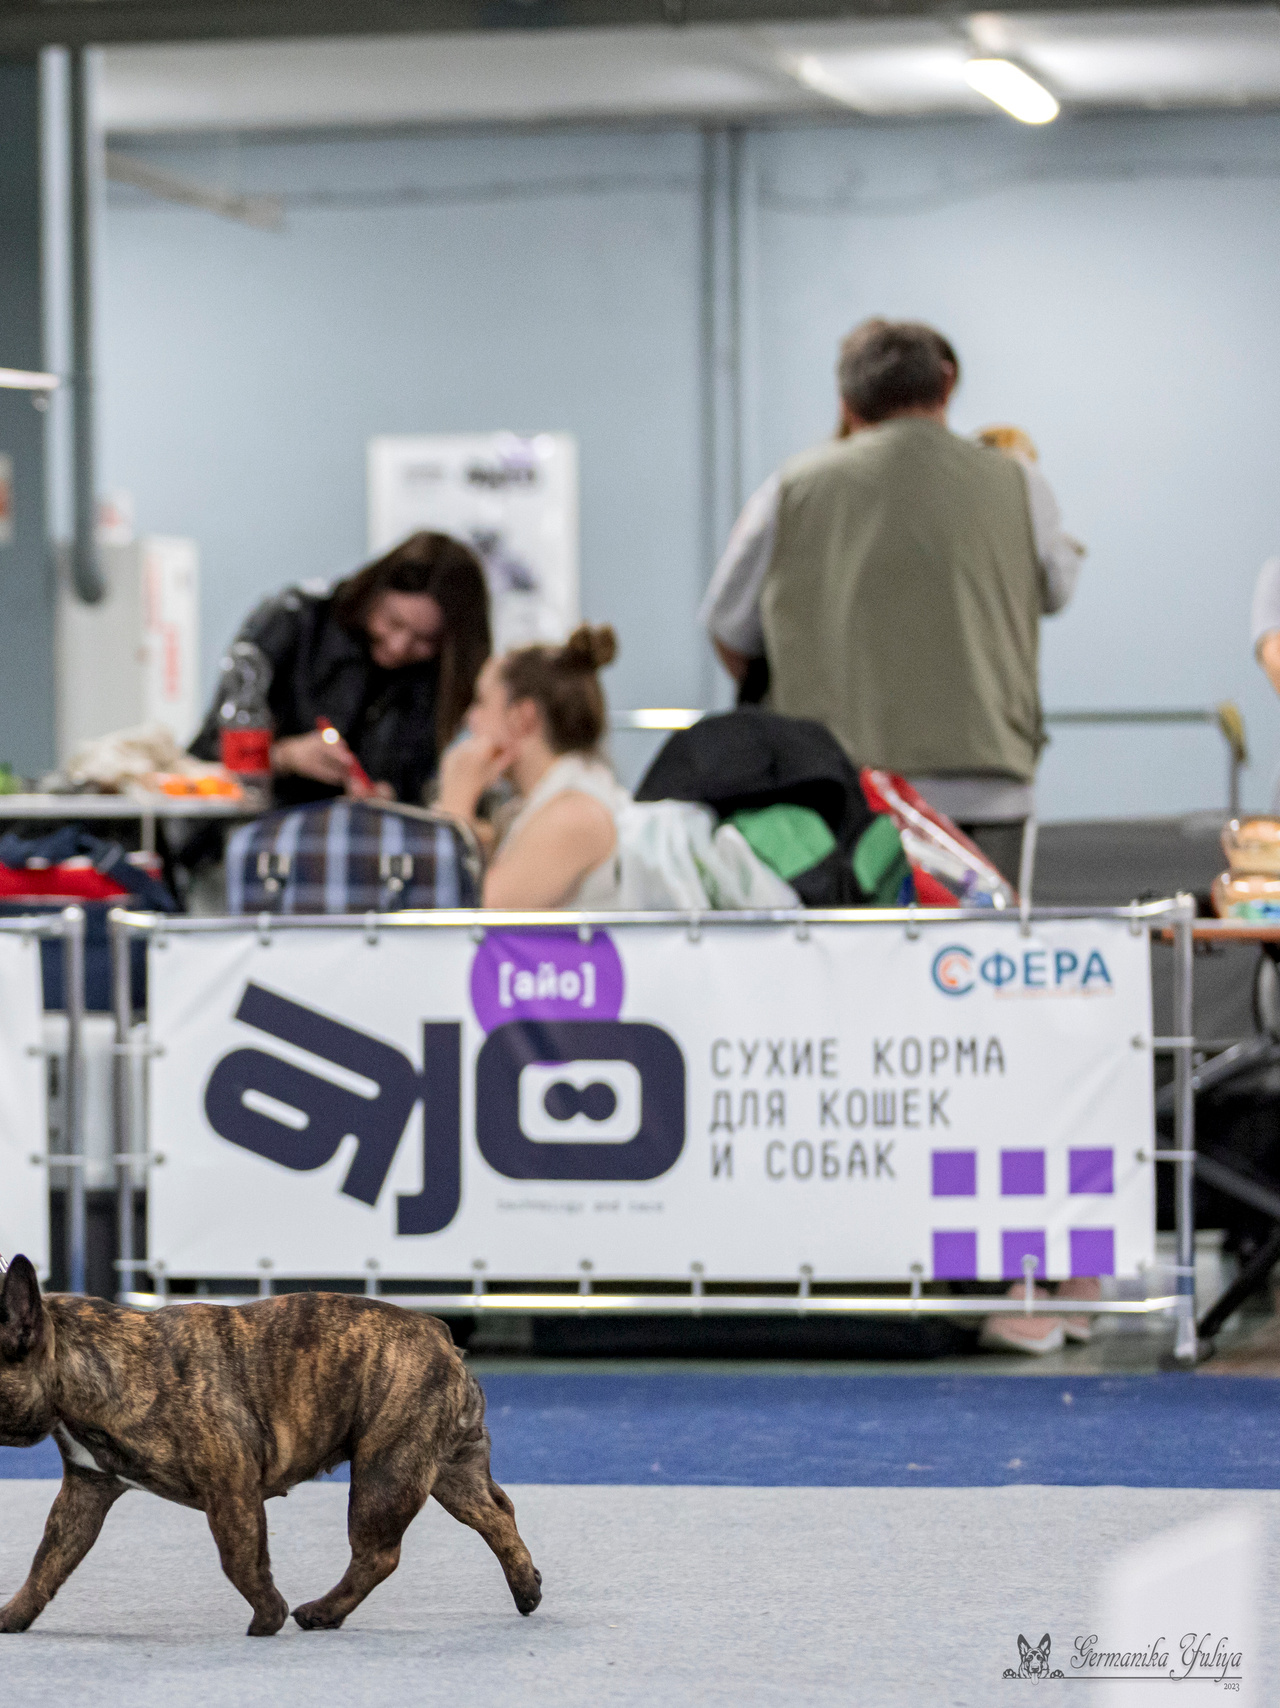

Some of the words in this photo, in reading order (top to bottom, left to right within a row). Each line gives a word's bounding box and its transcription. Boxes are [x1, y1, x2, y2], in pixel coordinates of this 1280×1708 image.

[931, 945, 1113, 996] СФЕРА
[710, 1039, 839, 1077] СУХИЕ
[873, 1038, 1006, 1076] КОРМА
[710, 1090, 787, 1134] ДЛЯ
[819, 1089, 951, 1129] КОШЕК
[710, 1142, 734, 1180] И
[765, 1140, 897, 1180] СОБАК
